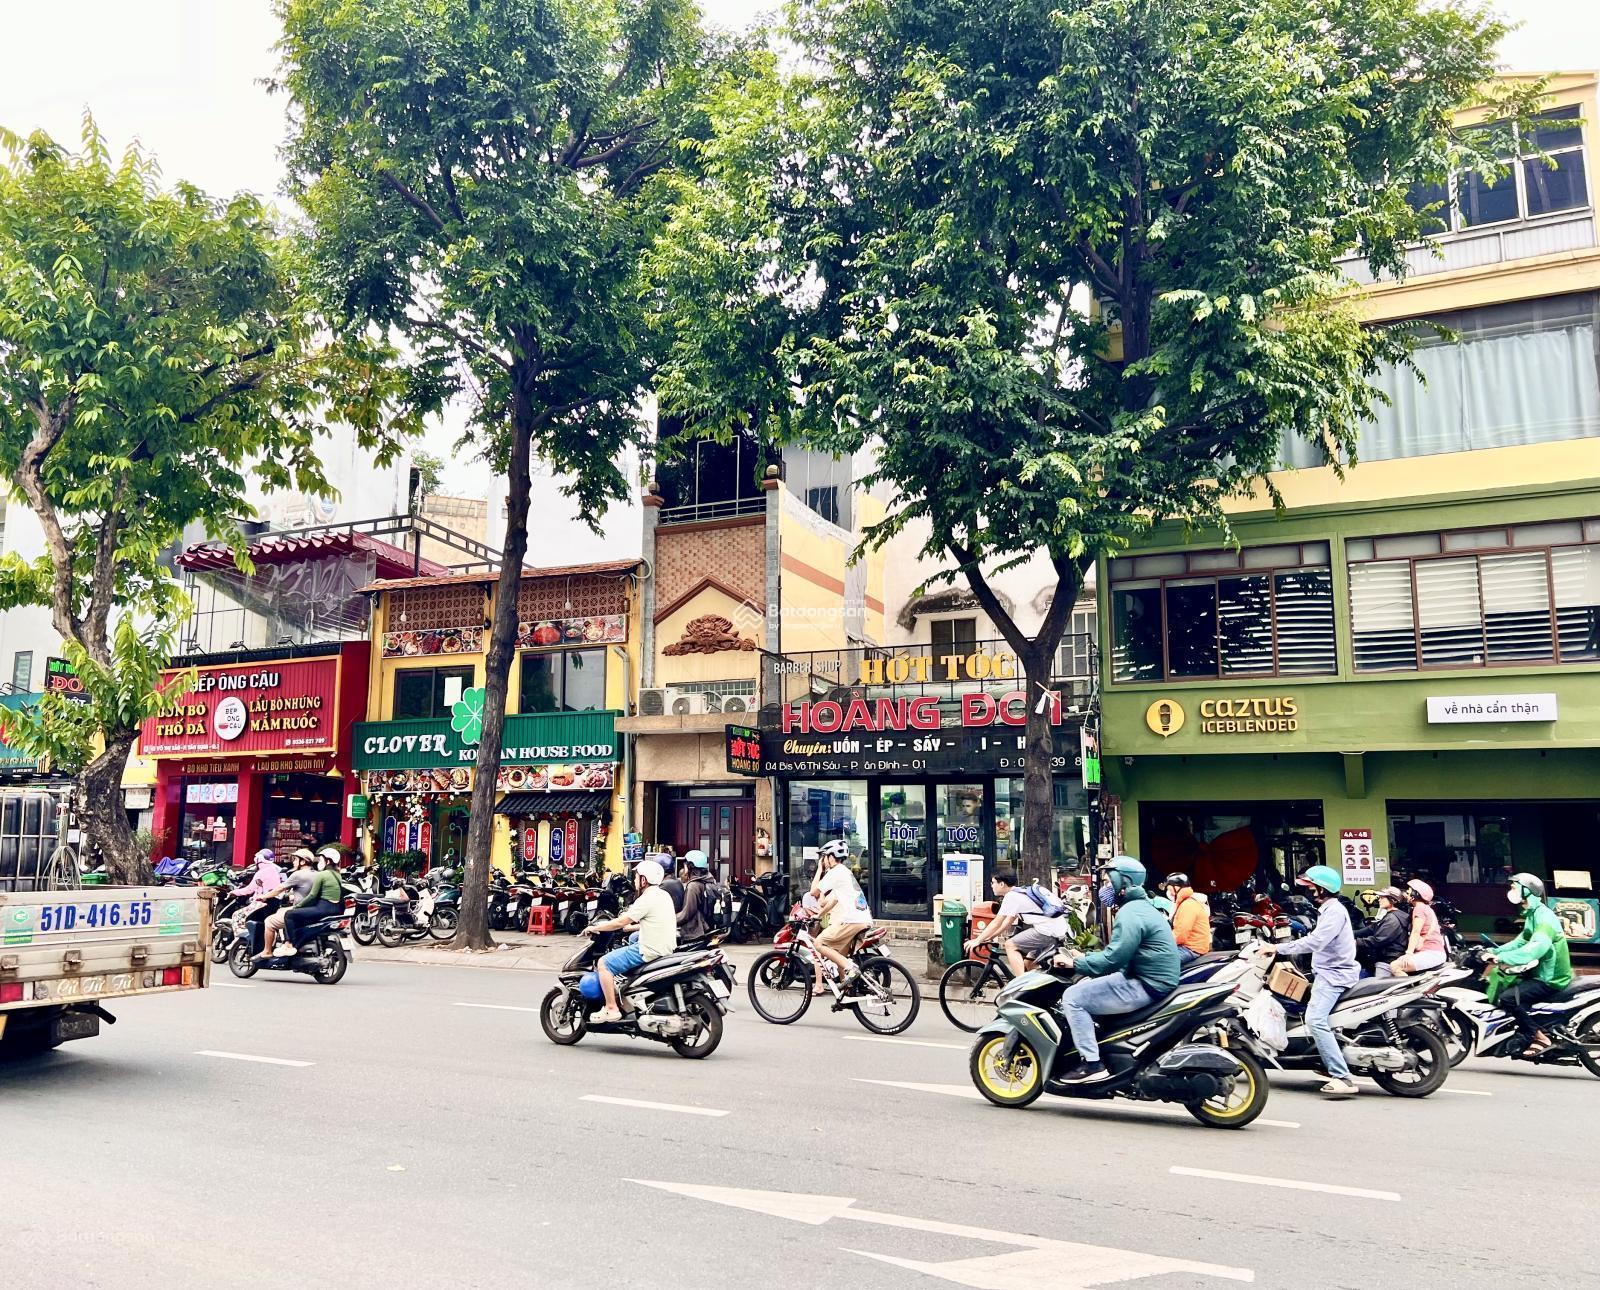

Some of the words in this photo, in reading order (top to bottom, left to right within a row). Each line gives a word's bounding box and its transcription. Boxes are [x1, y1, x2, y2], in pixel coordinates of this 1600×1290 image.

[774, 662, 812, 674] BARBER
[816, 660, 842, 673] SHOP
[218, 672, 247, 691] ÔNG
[249, 670, 279, 690] CẬU
[782, 690, 941, 734] HOÀNG
[1444, 701, 1458, 714] về
[1461, 703, 1483, 714] nhà
[1486, 700, 1507, 714] cẩn
[1511, 702, 1539, 715] thận
[156, 718, 184, 736] THỐ
[186, 719, 206, 735] ĐÁ
[250, 712, 281, 732] MẮM
[281, 711, 318, 730] RUỐC
[1202, 718, 1298, 734] ICEBLENDED
[364, 734, 453, 757] CLOVER
[459, 745, 517, 760] KOAN
[519, 745, 569, 759] HOUSE
[571, 743, 613, 757] FOOD
[832, 736, 860, 753] UỐN
[876, 737, 894, 753] ÉP
[913, 734, 941, 752] SẤY
[765, 761, 777, 770] 04
[779, 761, 793, 770] Bis
[822, 760, 841, 770] Sáu
[946, 823, 978, 842] TÓC
[40, 902, 152, 932] 51D-416.55
